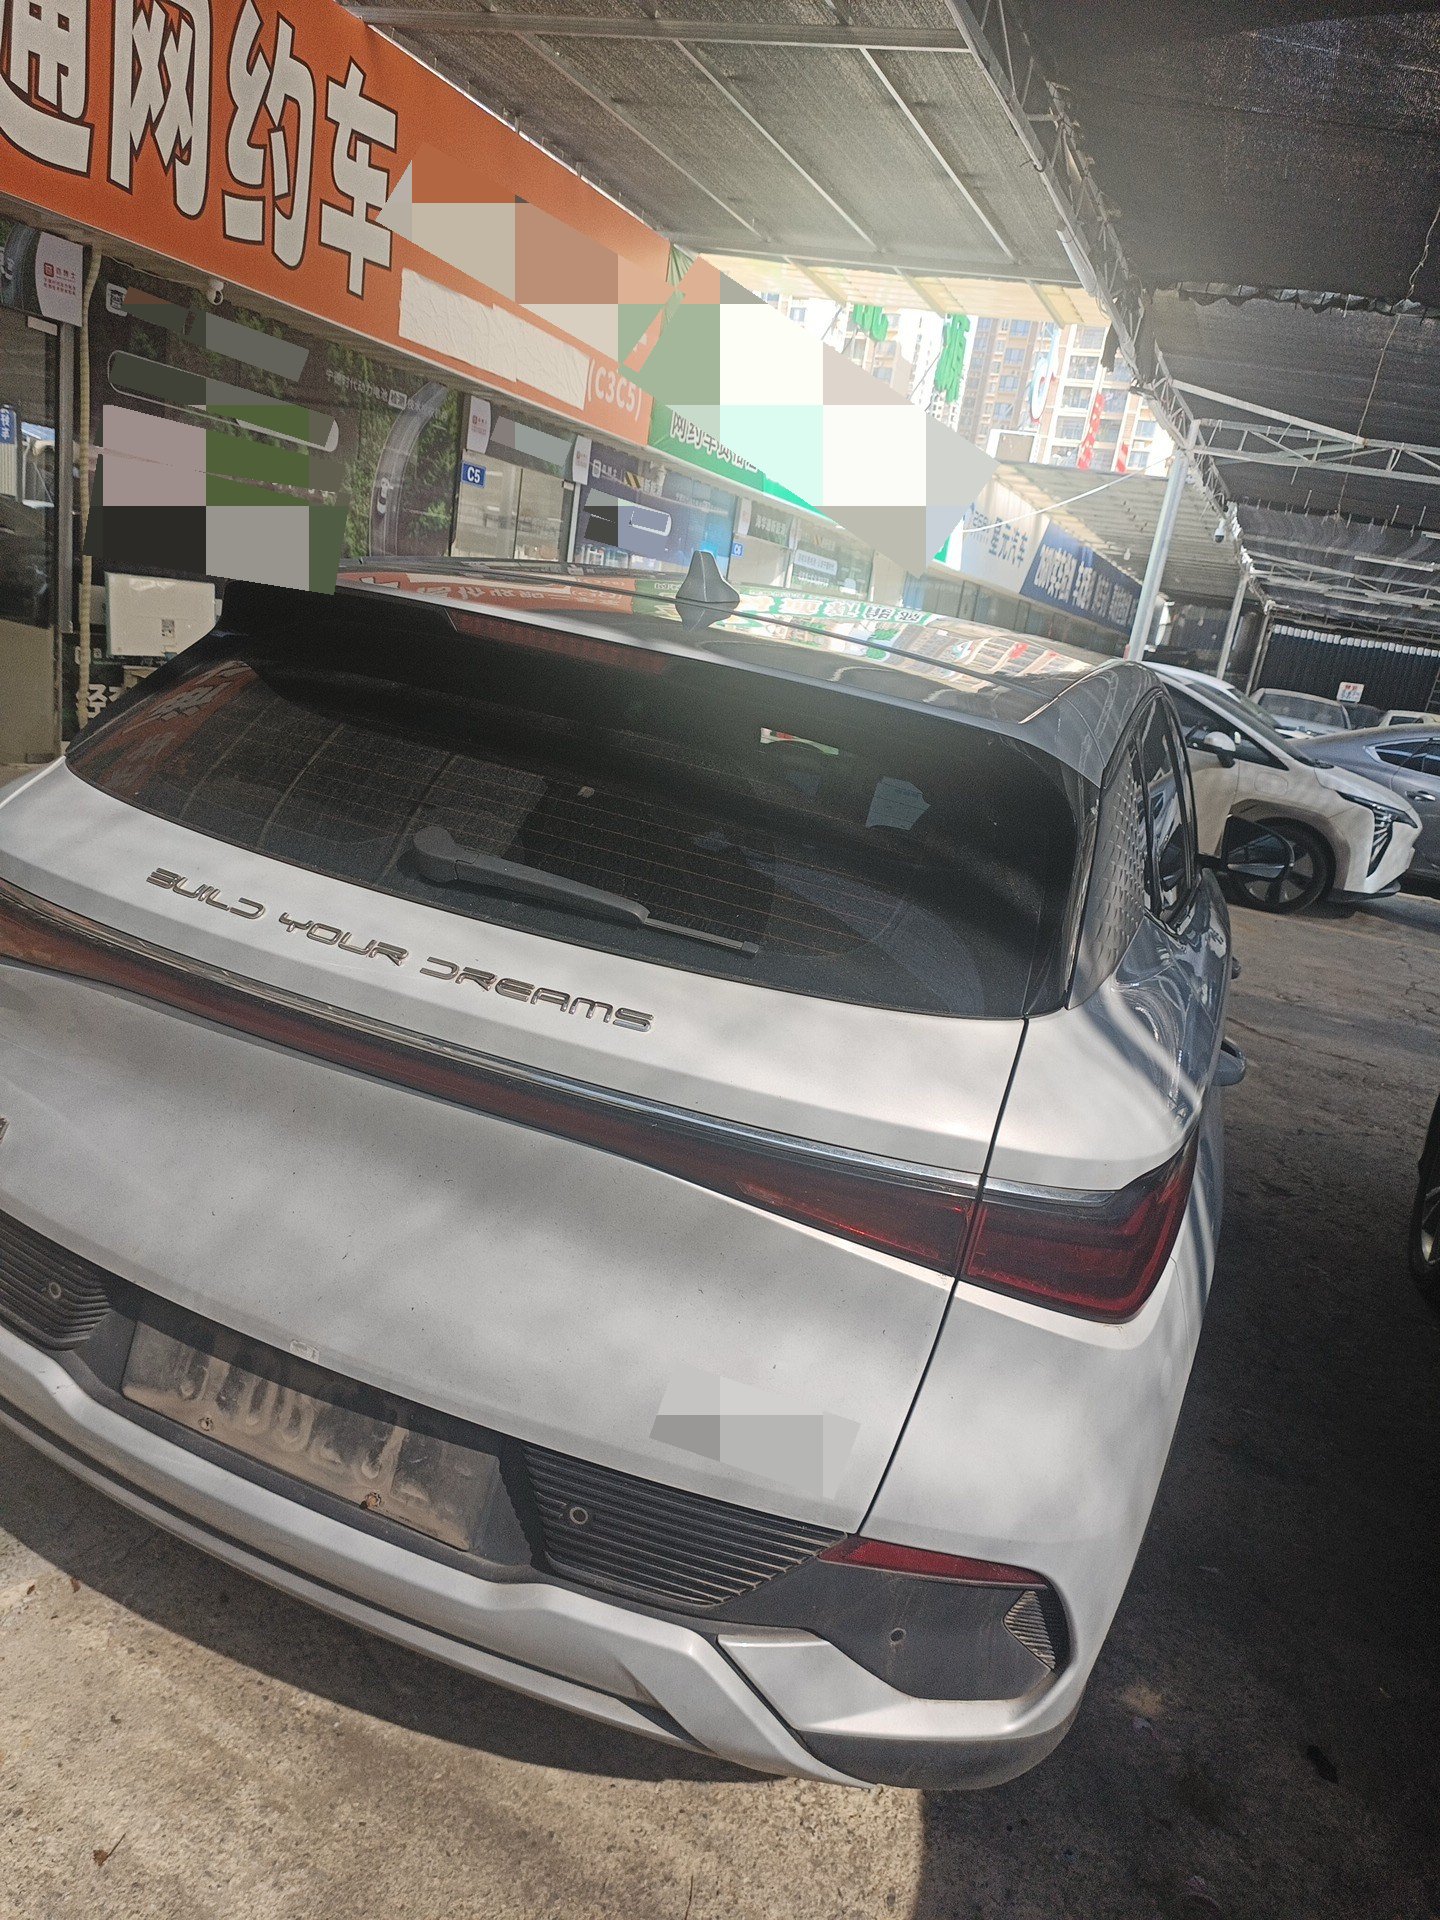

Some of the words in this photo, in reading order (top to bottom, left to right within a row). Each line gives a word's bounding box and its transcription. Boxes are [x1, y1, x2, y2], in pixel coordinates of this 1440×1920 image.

[587, 358, 642, 422] (C3C5)
[467, 465, 481, 484] C5
[146, 867, 267, 920] BUILD
[279, 910, 409, 967] YOUR
[420, 956, 655, 1033] DREAMS
